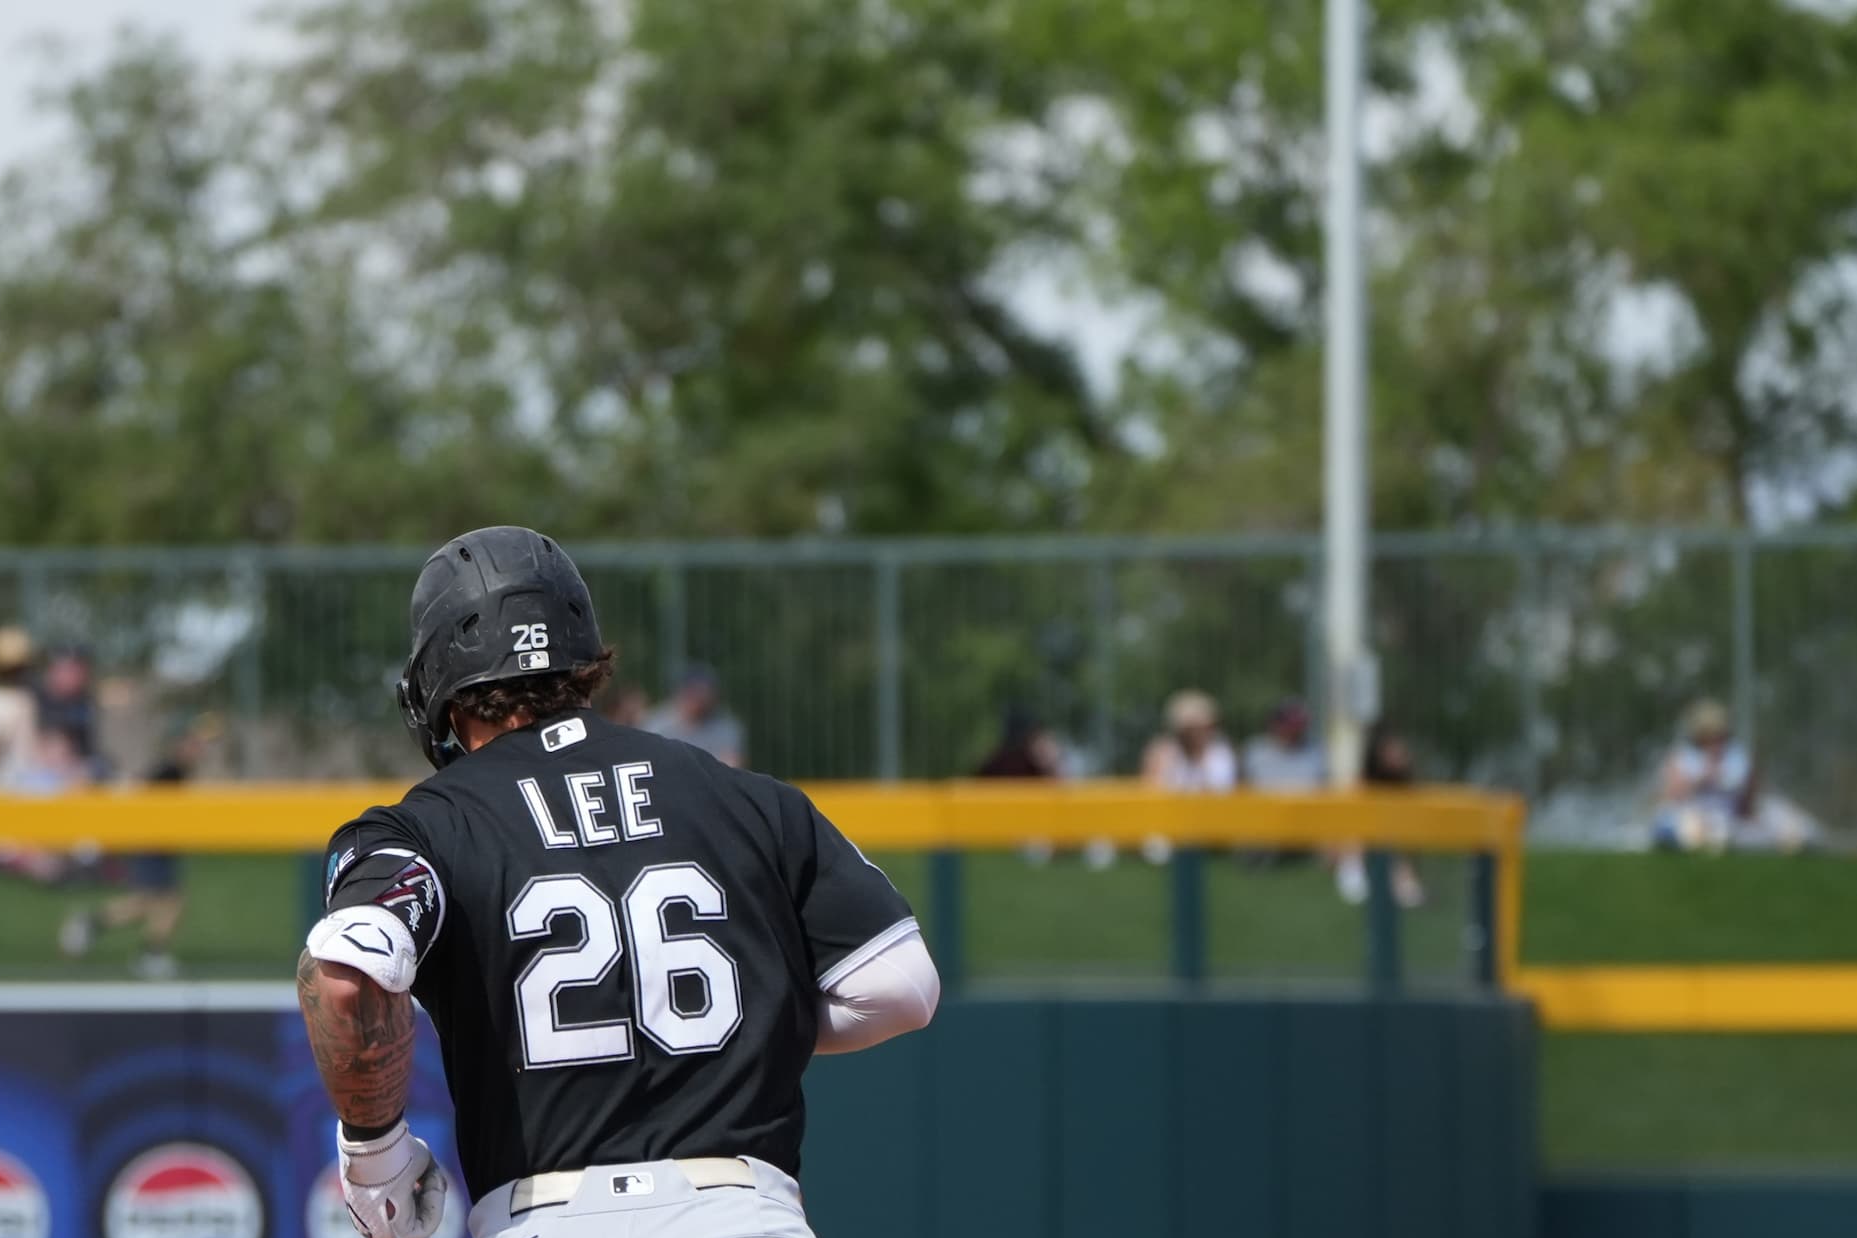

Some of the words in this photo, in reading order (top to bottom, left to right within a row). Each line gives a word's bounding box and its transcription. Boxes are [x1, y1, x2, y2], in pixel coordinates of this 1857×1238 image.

[511, 623, 549, 651] 26
[517, 761, 663, 850] LEE
[507, 860, 744, 1070] 26
